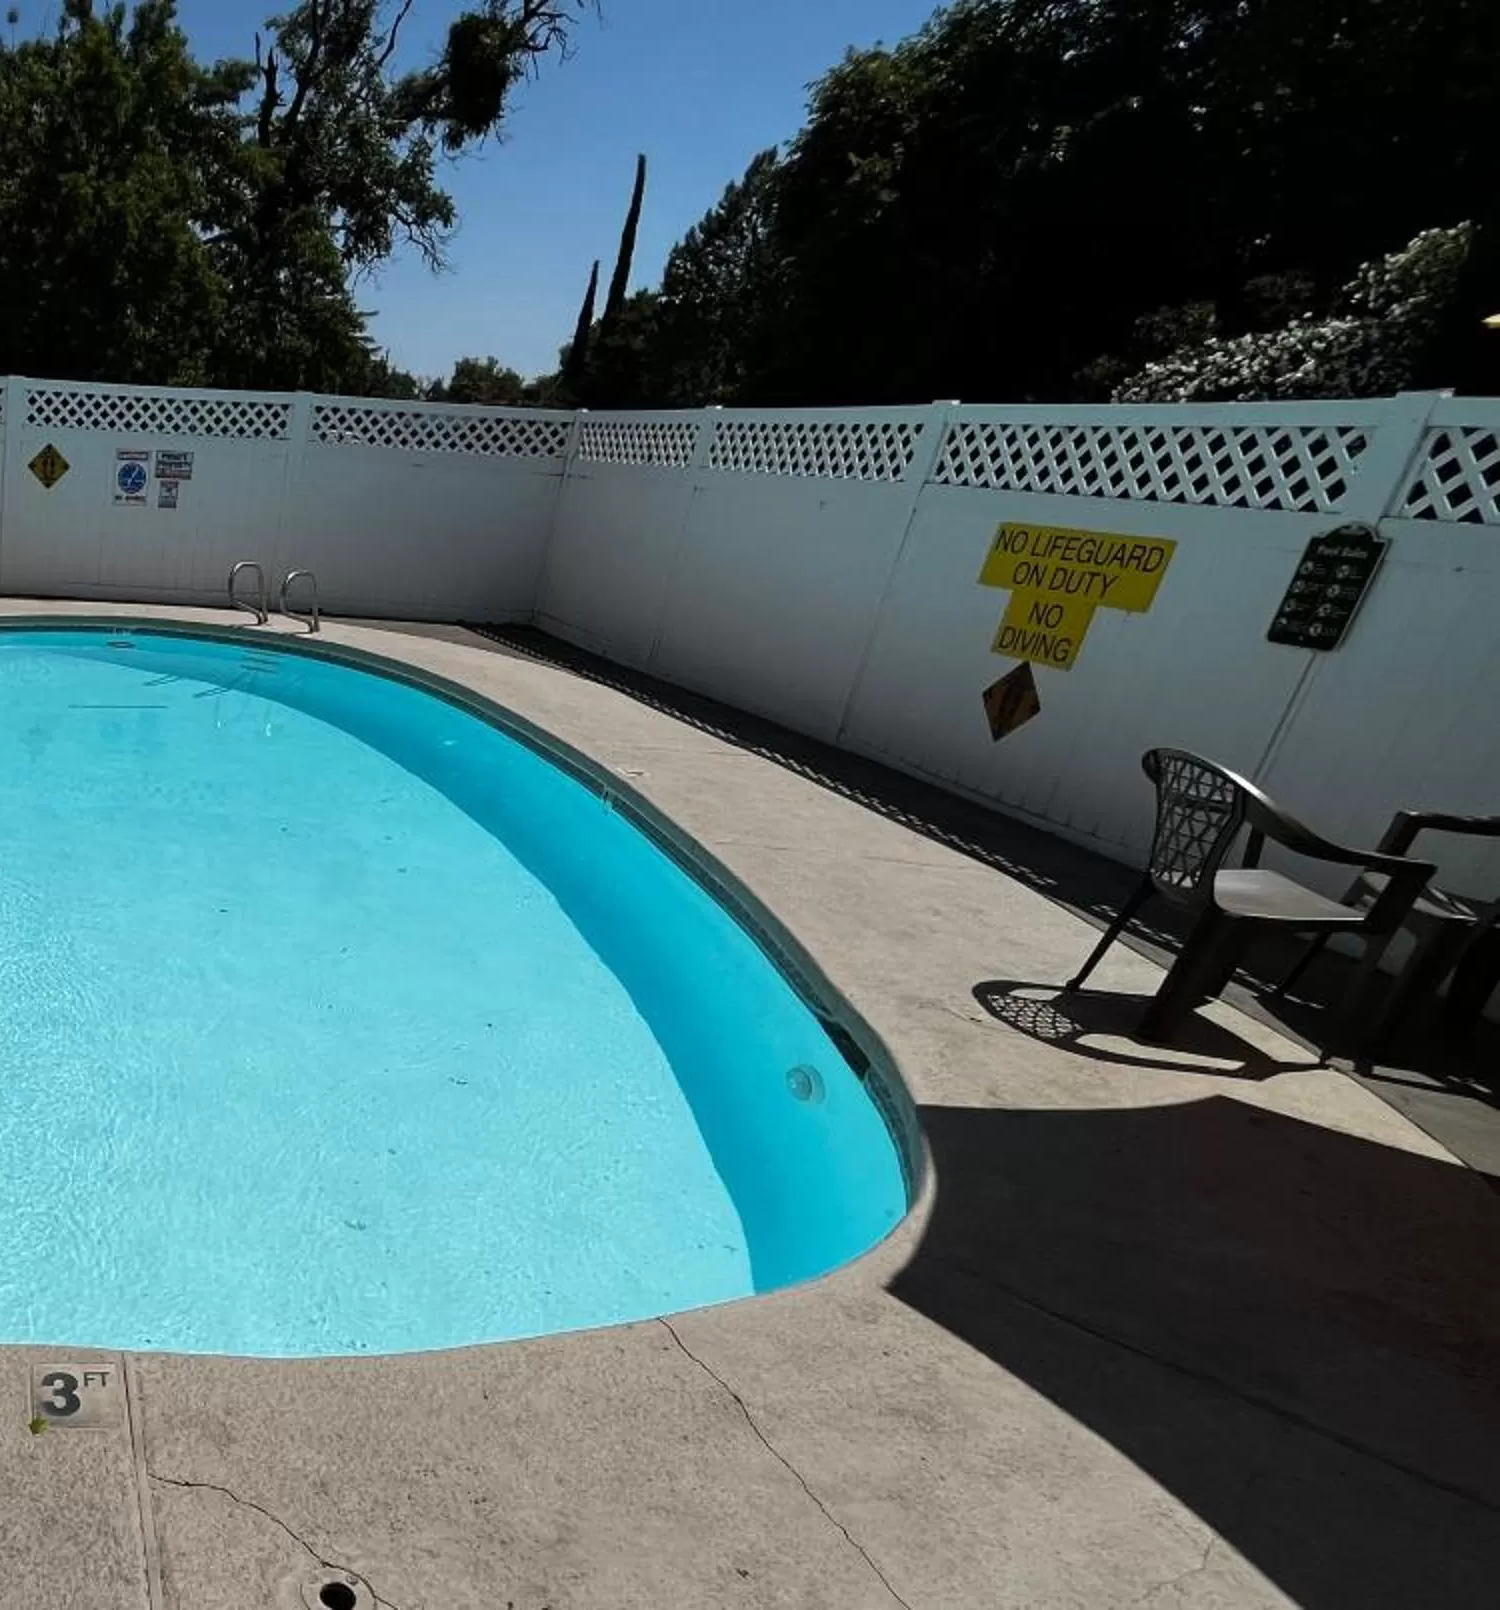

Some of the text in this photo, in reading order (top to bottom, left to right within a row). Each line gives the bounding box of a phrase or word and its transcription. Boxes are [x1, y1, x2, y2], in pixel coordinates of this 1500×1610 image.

[995, 529, 1165, 573] NO LIFEGUARD
[1012, 561, 1119, 600] ON DUTY
[1027, 601, 1064, 629] NO
[999, 626, 1072, 662] DIVING
[41, 1371, 110, 1416] 3 FT
